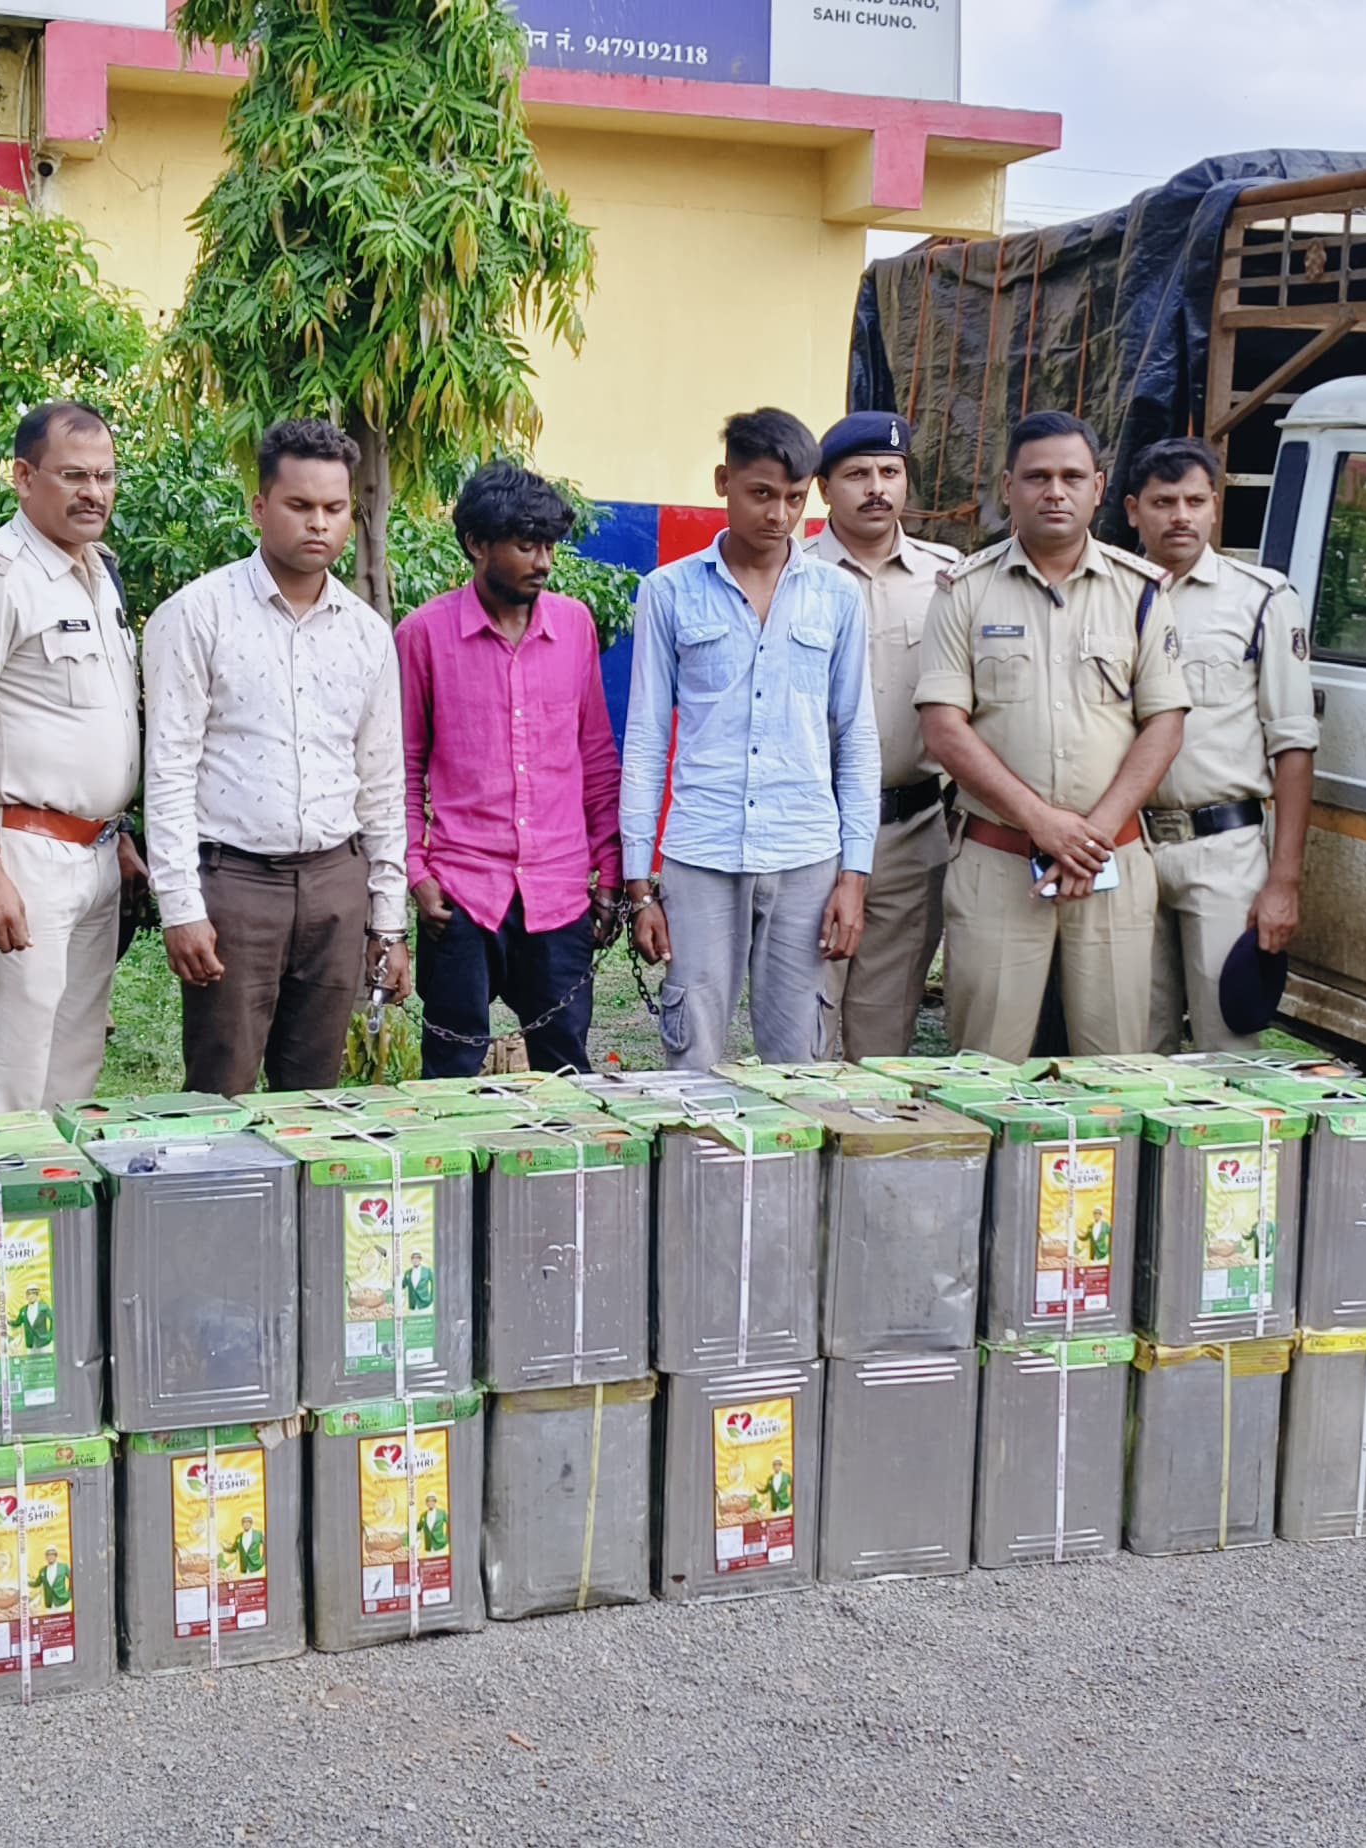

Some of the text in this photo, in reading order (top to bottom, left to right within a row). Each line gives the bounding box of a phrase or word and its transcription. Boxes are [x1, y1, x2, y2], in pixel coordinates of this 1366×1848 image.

[813, 7, 916, 29] SAHI CHUNO.
[585, 34, 708, 65] 9479192118
